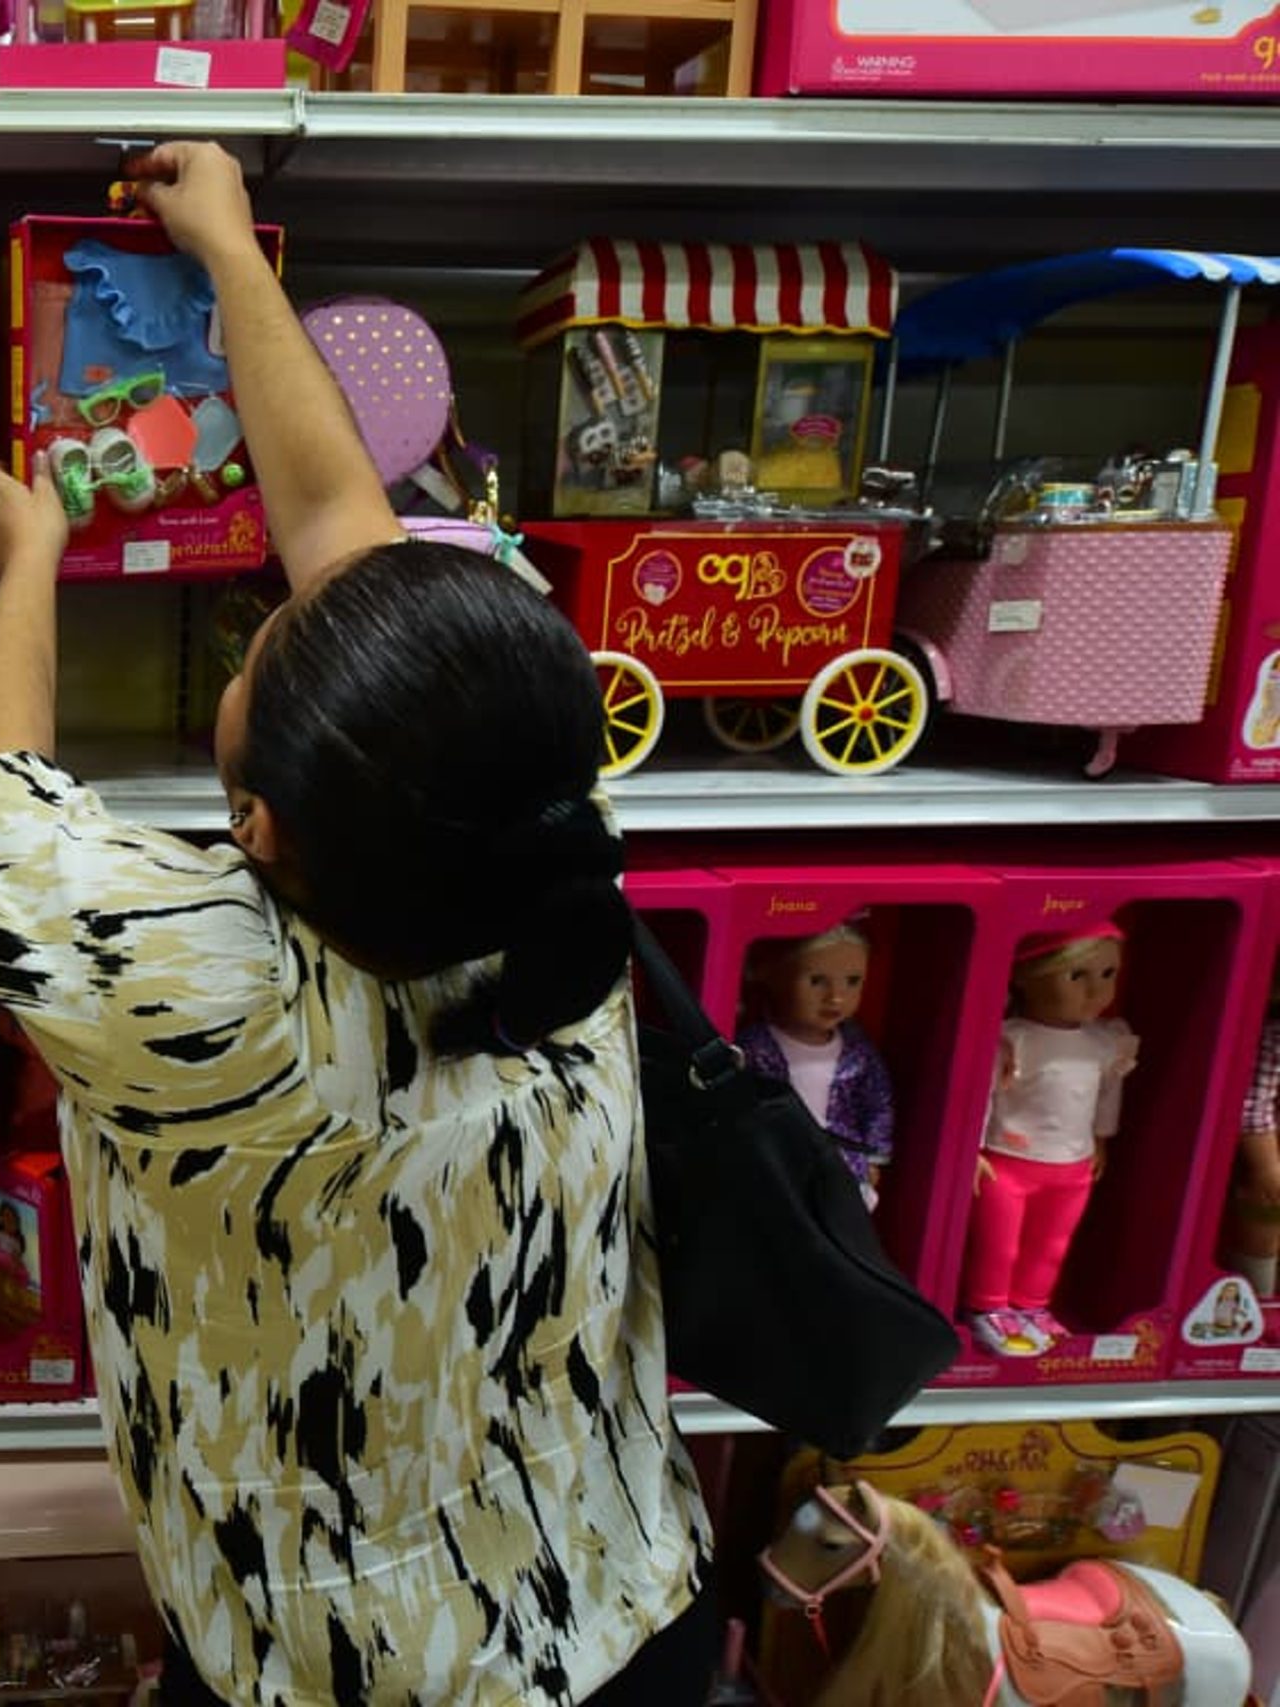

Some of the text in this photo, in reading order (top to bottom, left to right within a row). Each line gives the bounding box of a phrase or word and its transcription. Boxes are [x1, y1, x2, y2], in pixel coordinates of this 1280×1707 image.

[856, 54, 917, 69] WARNING
[615, 603, 849, 667] Pretzel & Popcorn
